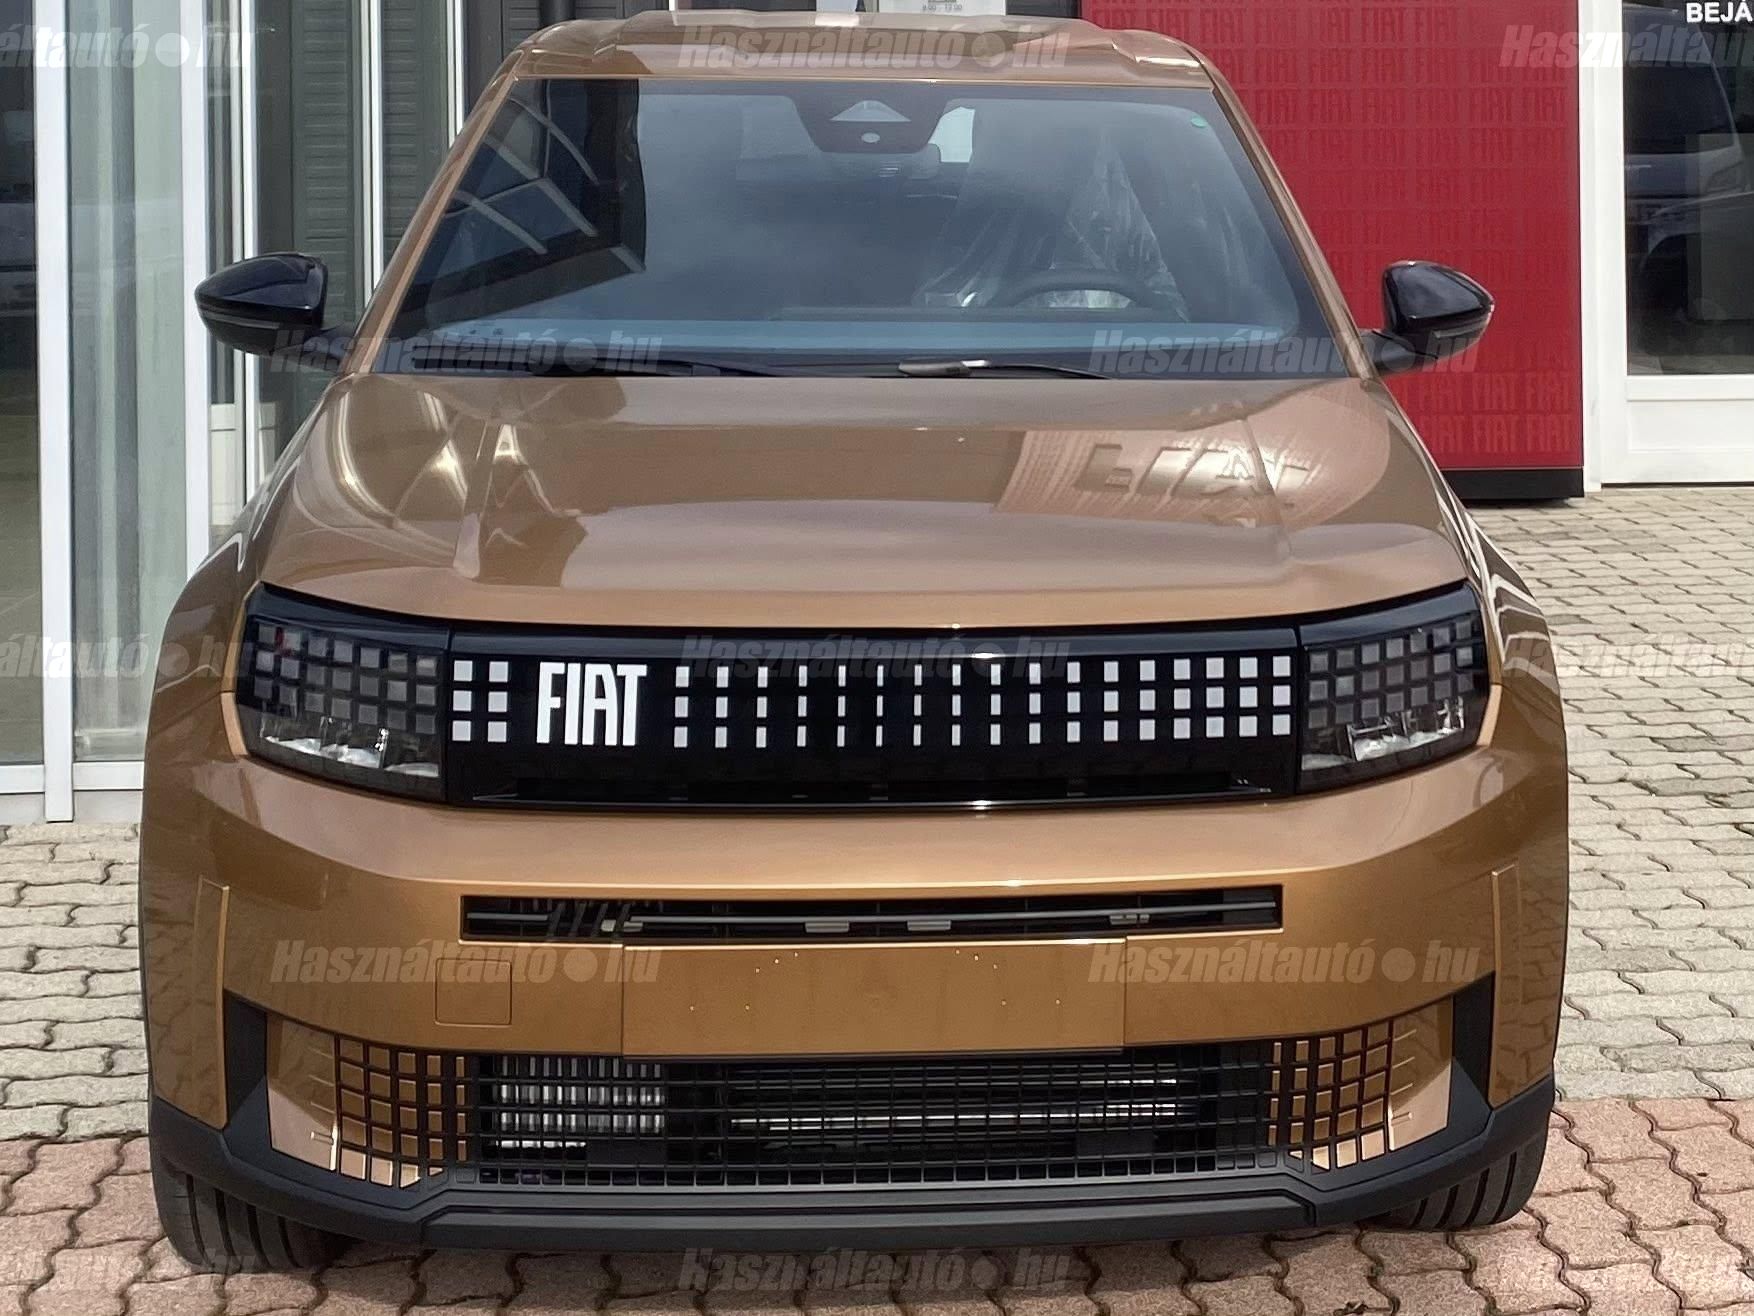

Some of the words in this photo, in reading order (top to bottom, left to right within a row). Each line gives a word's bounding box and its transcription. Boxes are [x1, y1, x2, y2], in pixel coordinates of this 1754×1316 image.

[1361, 8, 1405, 42] FIAT
[1686, 0, 1753, 22] BEJÁ
[1472, 415, 1519, 452] FIAT
[1525, 415, 1570, 452] FIAT
[537, 661, 647, 746] FIAT
